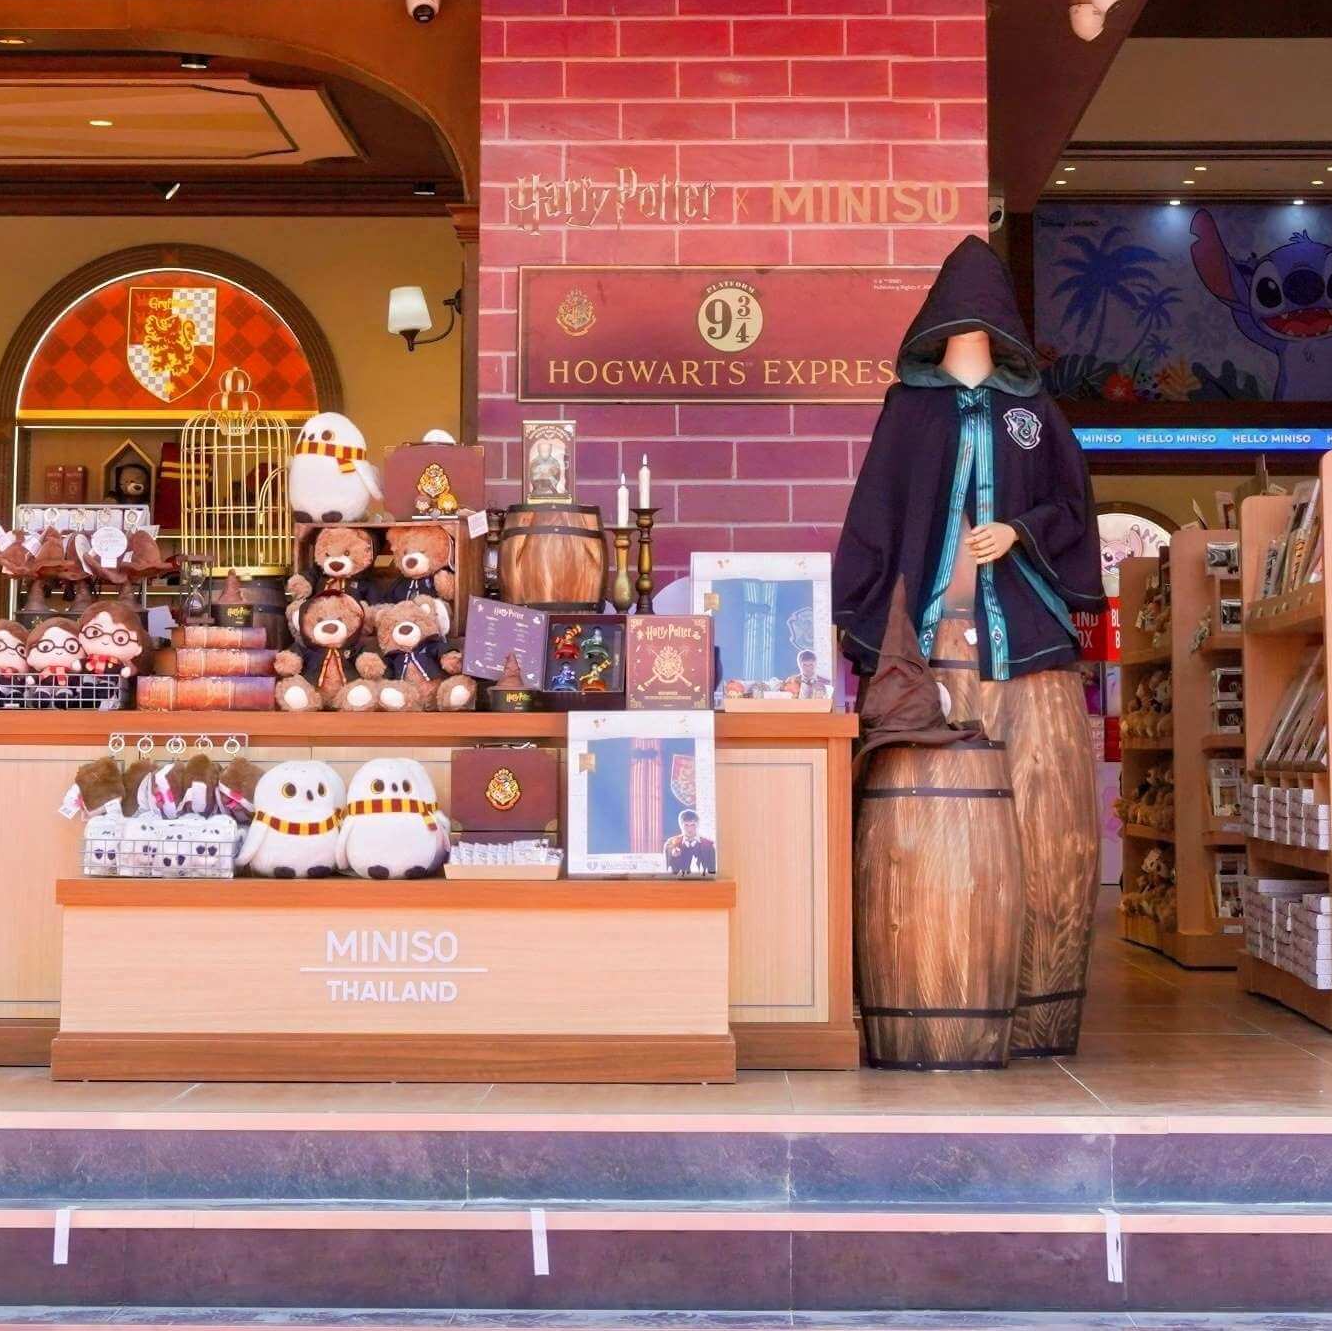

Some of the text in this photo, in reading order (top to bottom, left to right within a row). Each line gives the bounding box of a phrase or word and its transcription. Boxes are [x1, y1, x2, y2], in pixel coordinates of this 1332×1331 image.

[508, 172, 611, 237] Harry
[613, 166, 716, 231] Potter
[771, 180, 960, 224] MINISO
[705, 280, 757, 294] PLATFORM
[548, 358, 902, 387] HOGWARTS EXPRES
[1082, 434, 1122, 444] MINISO
[1137, 434, 1217, 444] HELLO MINISO
[1232, 434, 1311, 444] HELLO MINISO
[645, 623, 691, 641] Harry Potter
[325, 929, 459, 964] MINISO
[326, 980, 459, 1003] THAILAND
